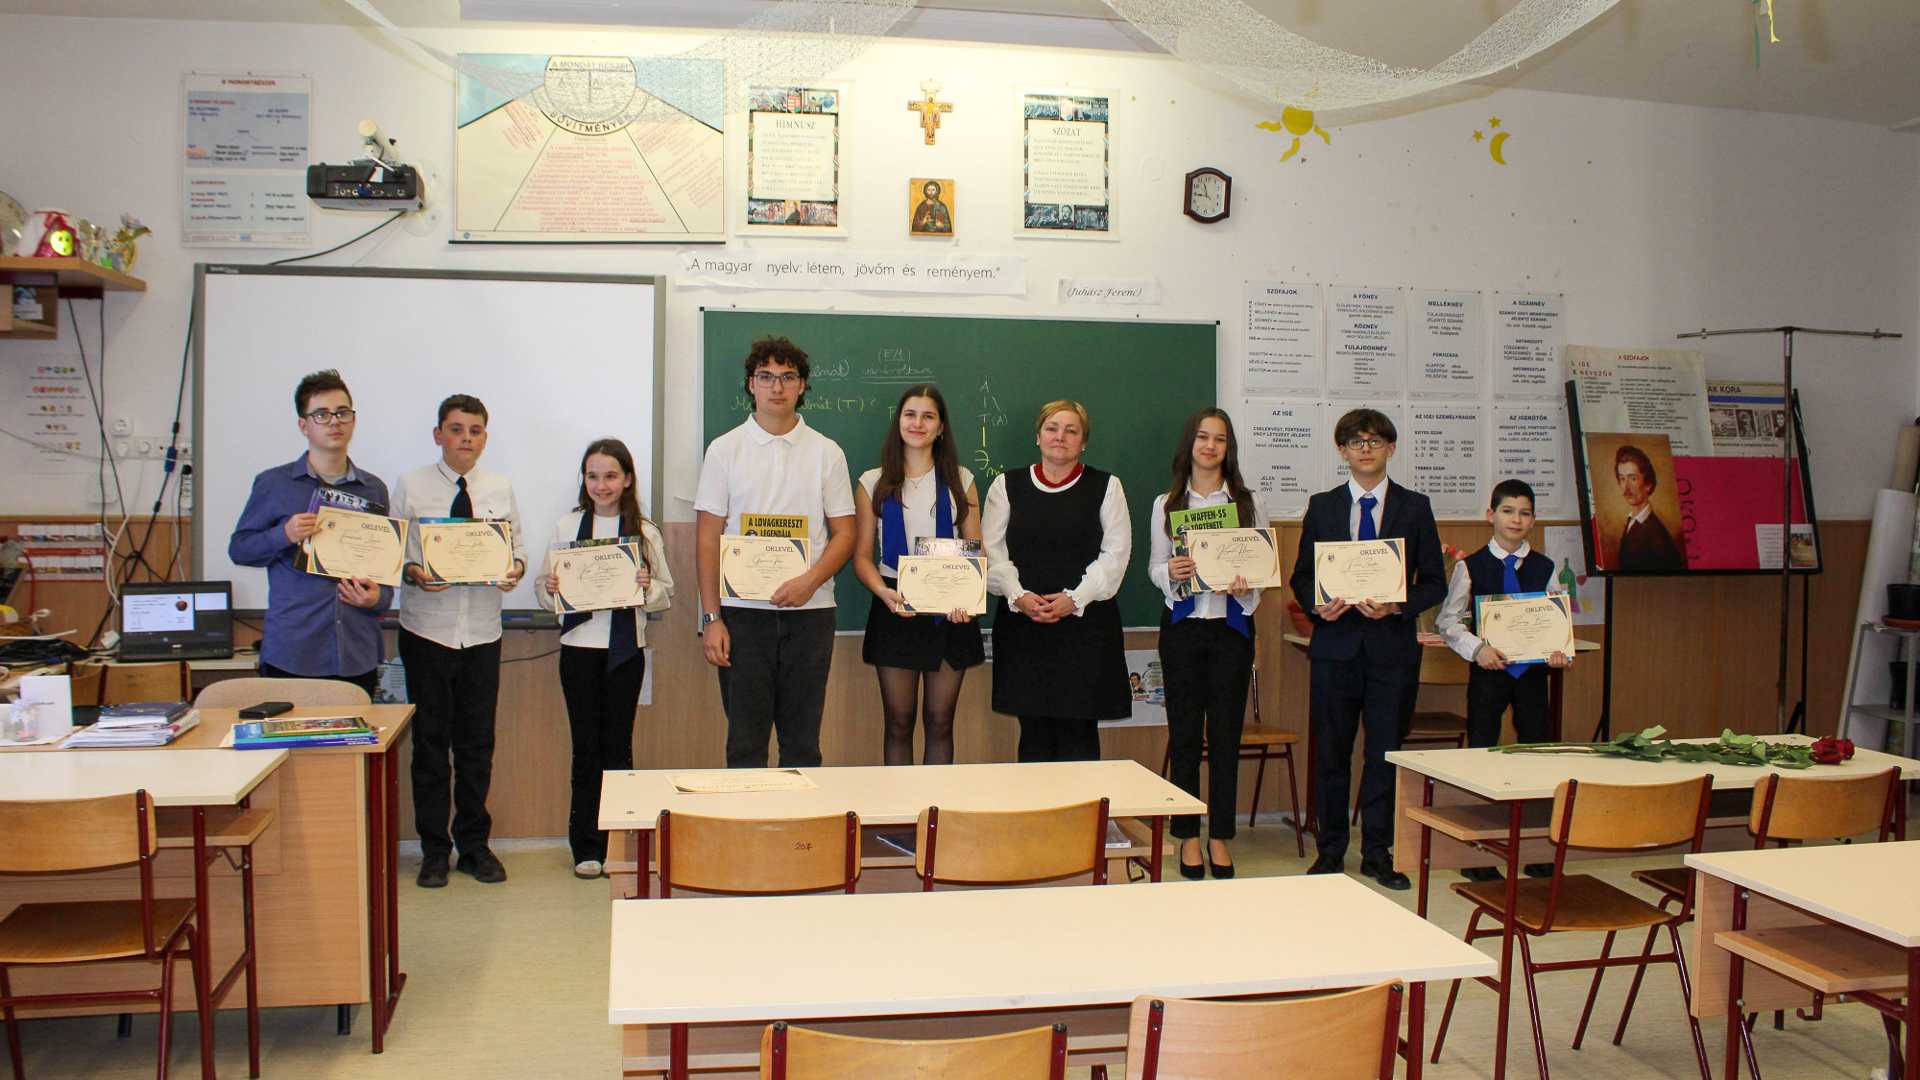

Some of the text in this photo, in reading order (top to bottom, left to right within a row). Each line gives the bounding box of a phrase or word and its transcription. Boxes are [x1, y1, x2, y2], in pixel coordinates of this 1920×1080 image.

[776, 120, 816, 130] HIMNUSZ
[1053, 127, 1081, 136] SZÓZAT
[705, 260, 753, 274] magyar
[767, 261, 802, 278] nyelv:
[807, 261, 845, 276] létem,
[854, 262, 895, 278] jövőm
[902, 264, 916, 276] és
[1067, 287, 1142, 298] (Juhász Ferenc)
[1184, 509, 1227, 523] A WAFFEN-SS
[361, 522, 390, 533] OKLEVÉL
[749, 518, 803, 528] A LOVAGKERESZT
[1190, 521, 1223, 530] TÖRTÉNETE
[761, 529, 791, 538] LEGENDÁJA
